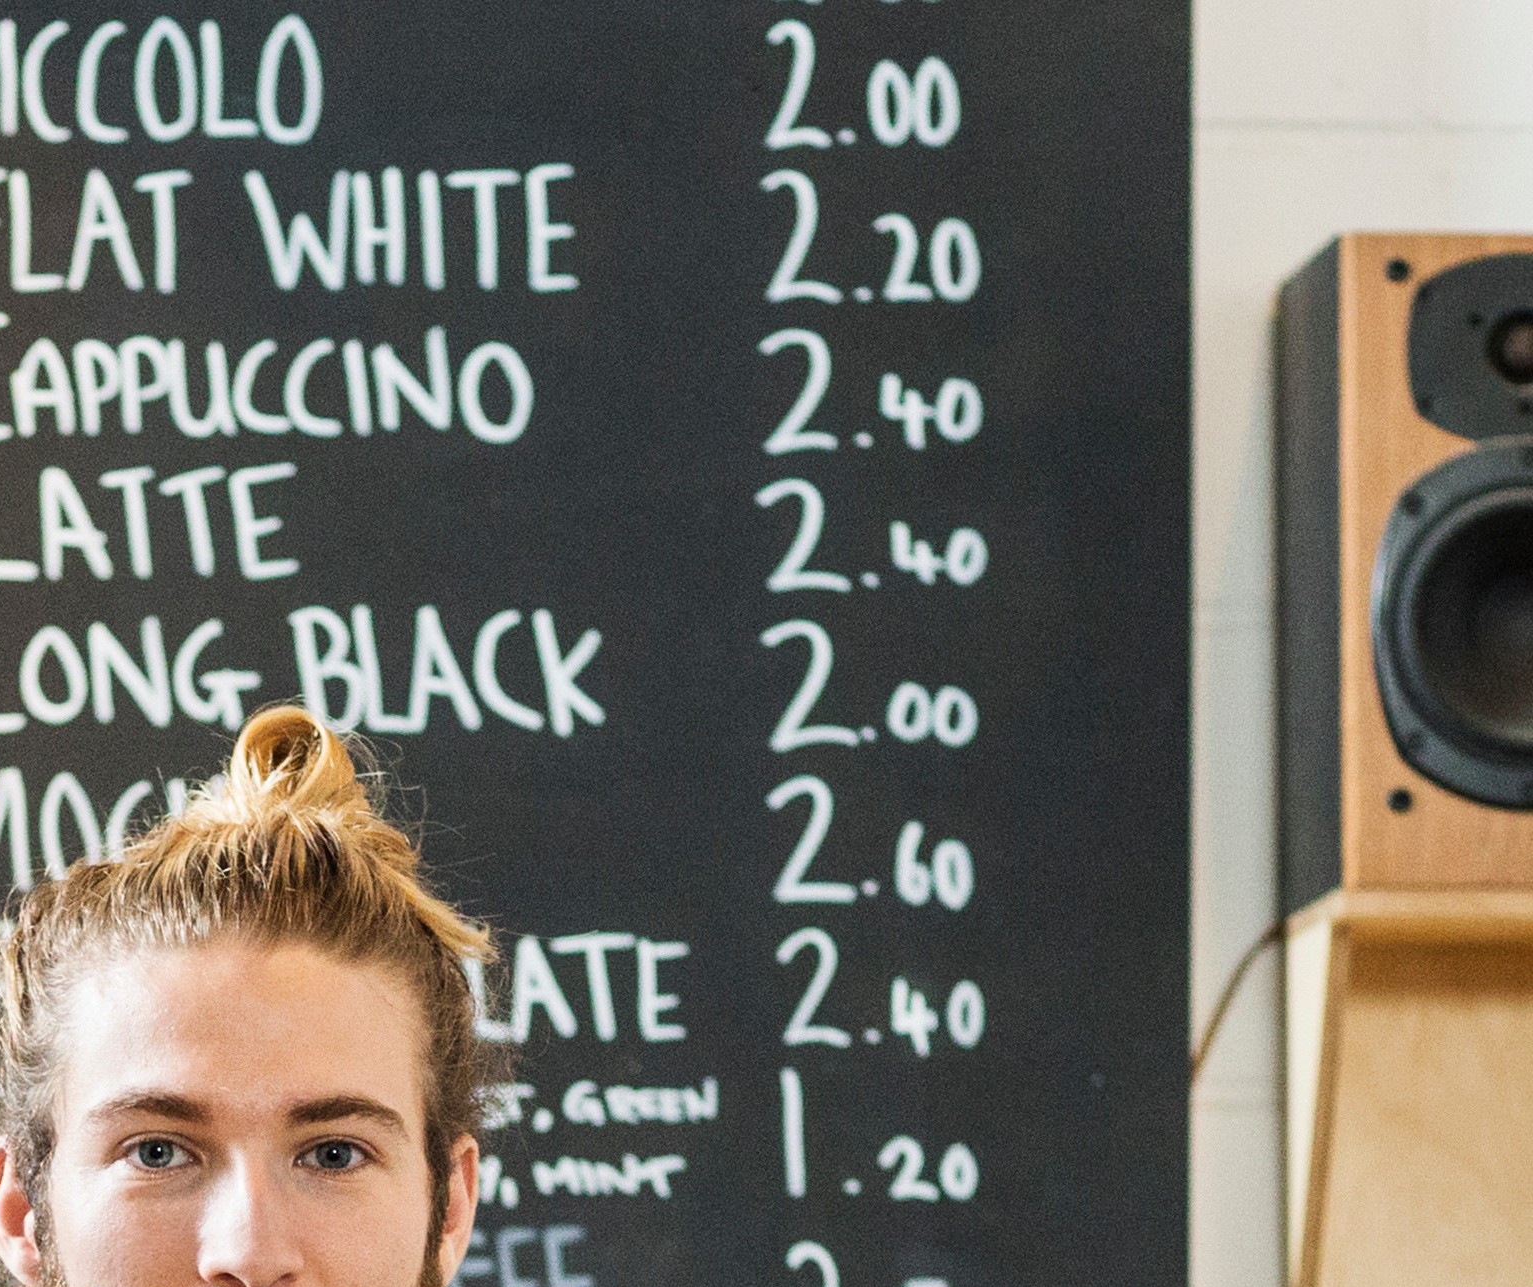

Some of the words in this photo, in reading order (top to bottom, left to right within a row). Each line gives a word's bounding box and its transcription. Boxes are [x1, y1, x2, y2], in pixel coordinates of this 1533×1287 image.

[764, 19, 961, 150] 2.00
[243, 162, 579, 293] WHITE
[760, 168, 981, 304] 2.20
[758, 328, 983, 455] 2.40
[755, 478, 988, 593] 2.40
[289, 603, 606, 740] BLACK
[760, 619, 979, 753] 2.00
[766, 774, 974, 911] 2.60
[775, 927, 985, 1057] 2.40
[534, 1153, 686, 1199] MINT
[561, 1077, 720, 1127] GREEN
[780, 1067, 979, 1202] 1.20
